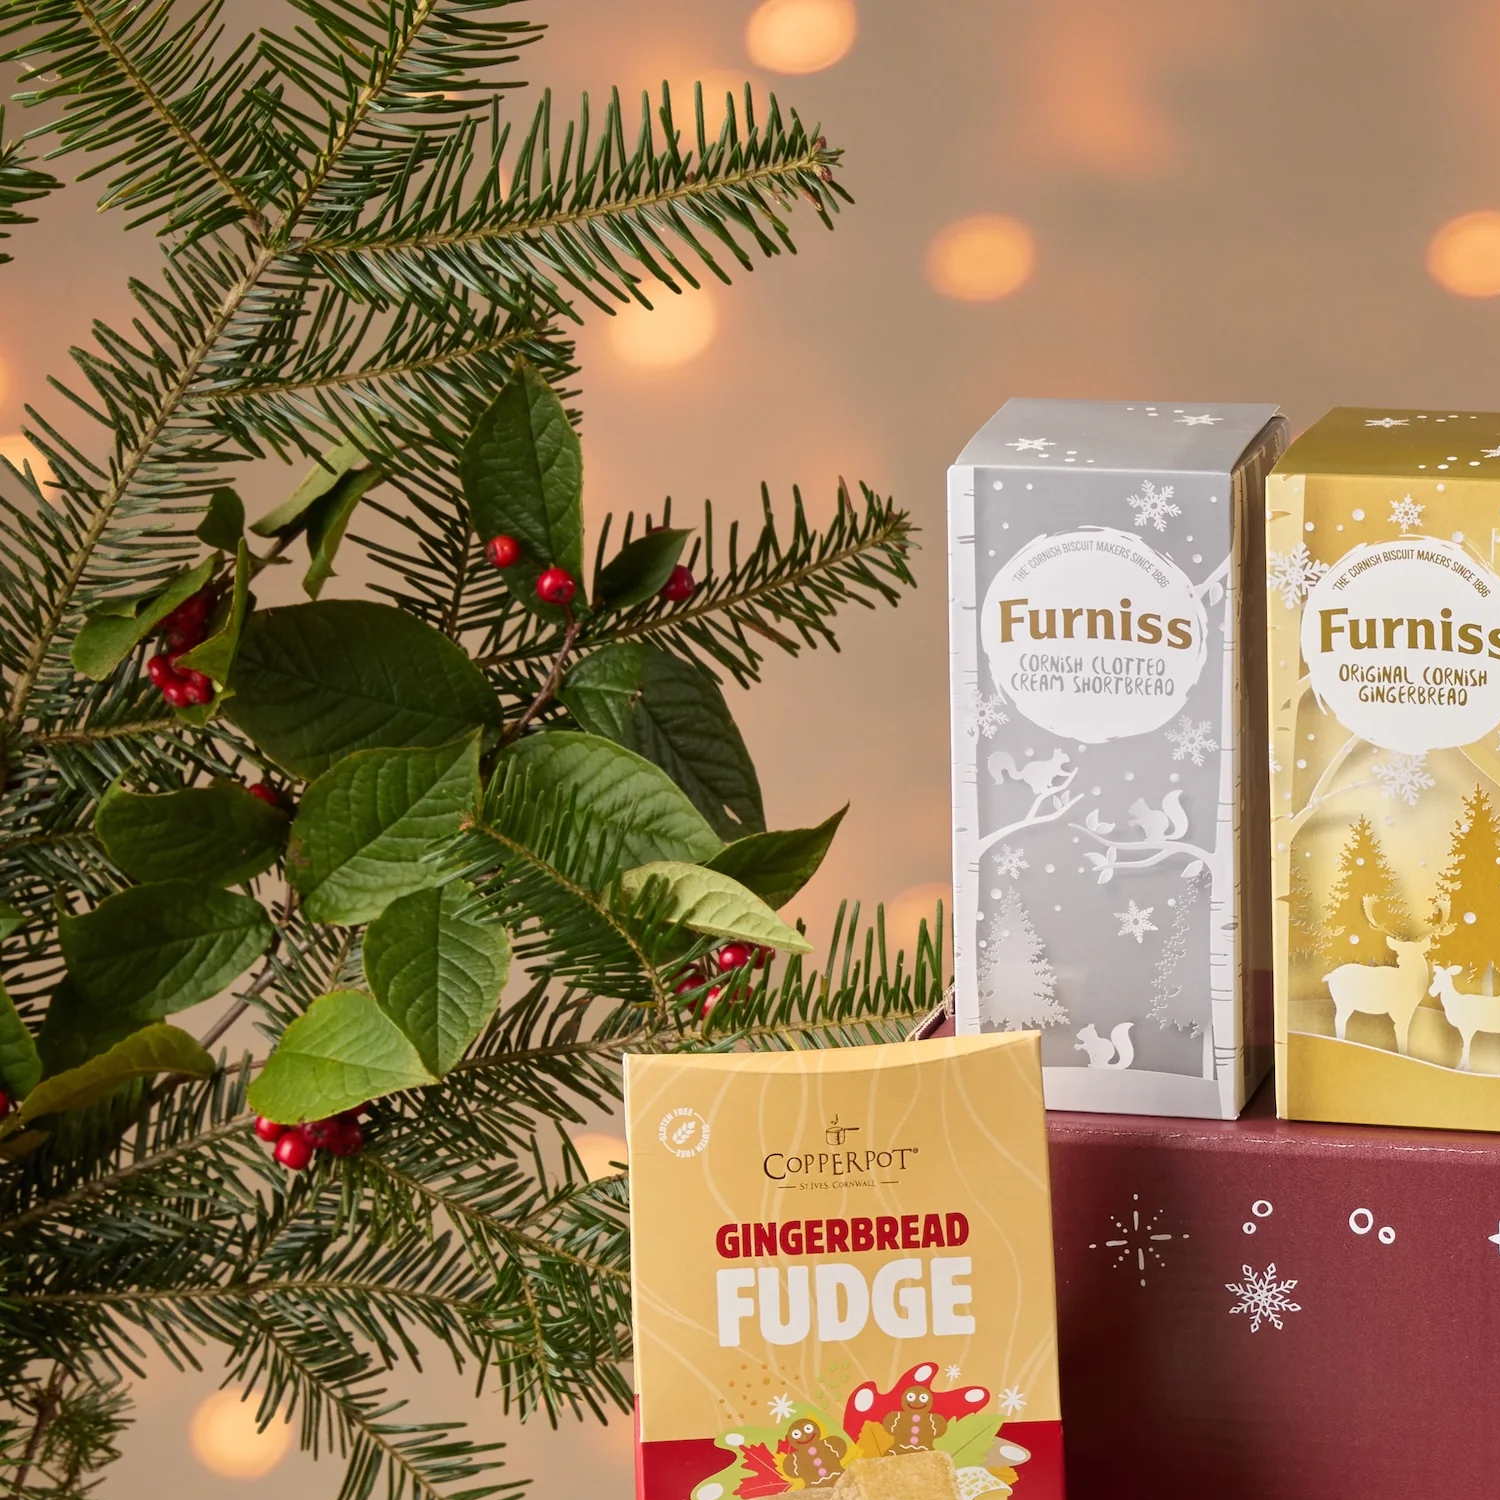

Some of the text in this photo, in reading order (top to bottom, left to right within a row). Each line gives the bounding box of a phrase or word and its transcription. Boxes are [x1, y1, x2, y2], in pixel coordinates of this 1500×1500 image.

[1028, 546, 1062, 570] CORNISH
[1062, 540, 1094, 554] BISCUIT
[1096, 541, 1130, 559] MAKERS
[1130, 552, 1153, 573] SINCE
[1151, 569, 1170, 589] 1886
[1348, 555, 1383, 579] CORNISH
[1383, 548, 1415, 562] BISCUIT
[1417, 550, 1451, 569] MAKERS
[1451, 562, 1476, 584] SINCE
[1472, 578, 1491, 599] 1886
[999, 598, 1193, 650] Furniss
[1011, 672, 1175, 697] CREAM SHORTBREAD
[1092, 656, 1166, 676] CLOTTED
[716, 1212, 970, 1259] GINGERBREAD
[716, 1256, 976, 1348] FUDGE
